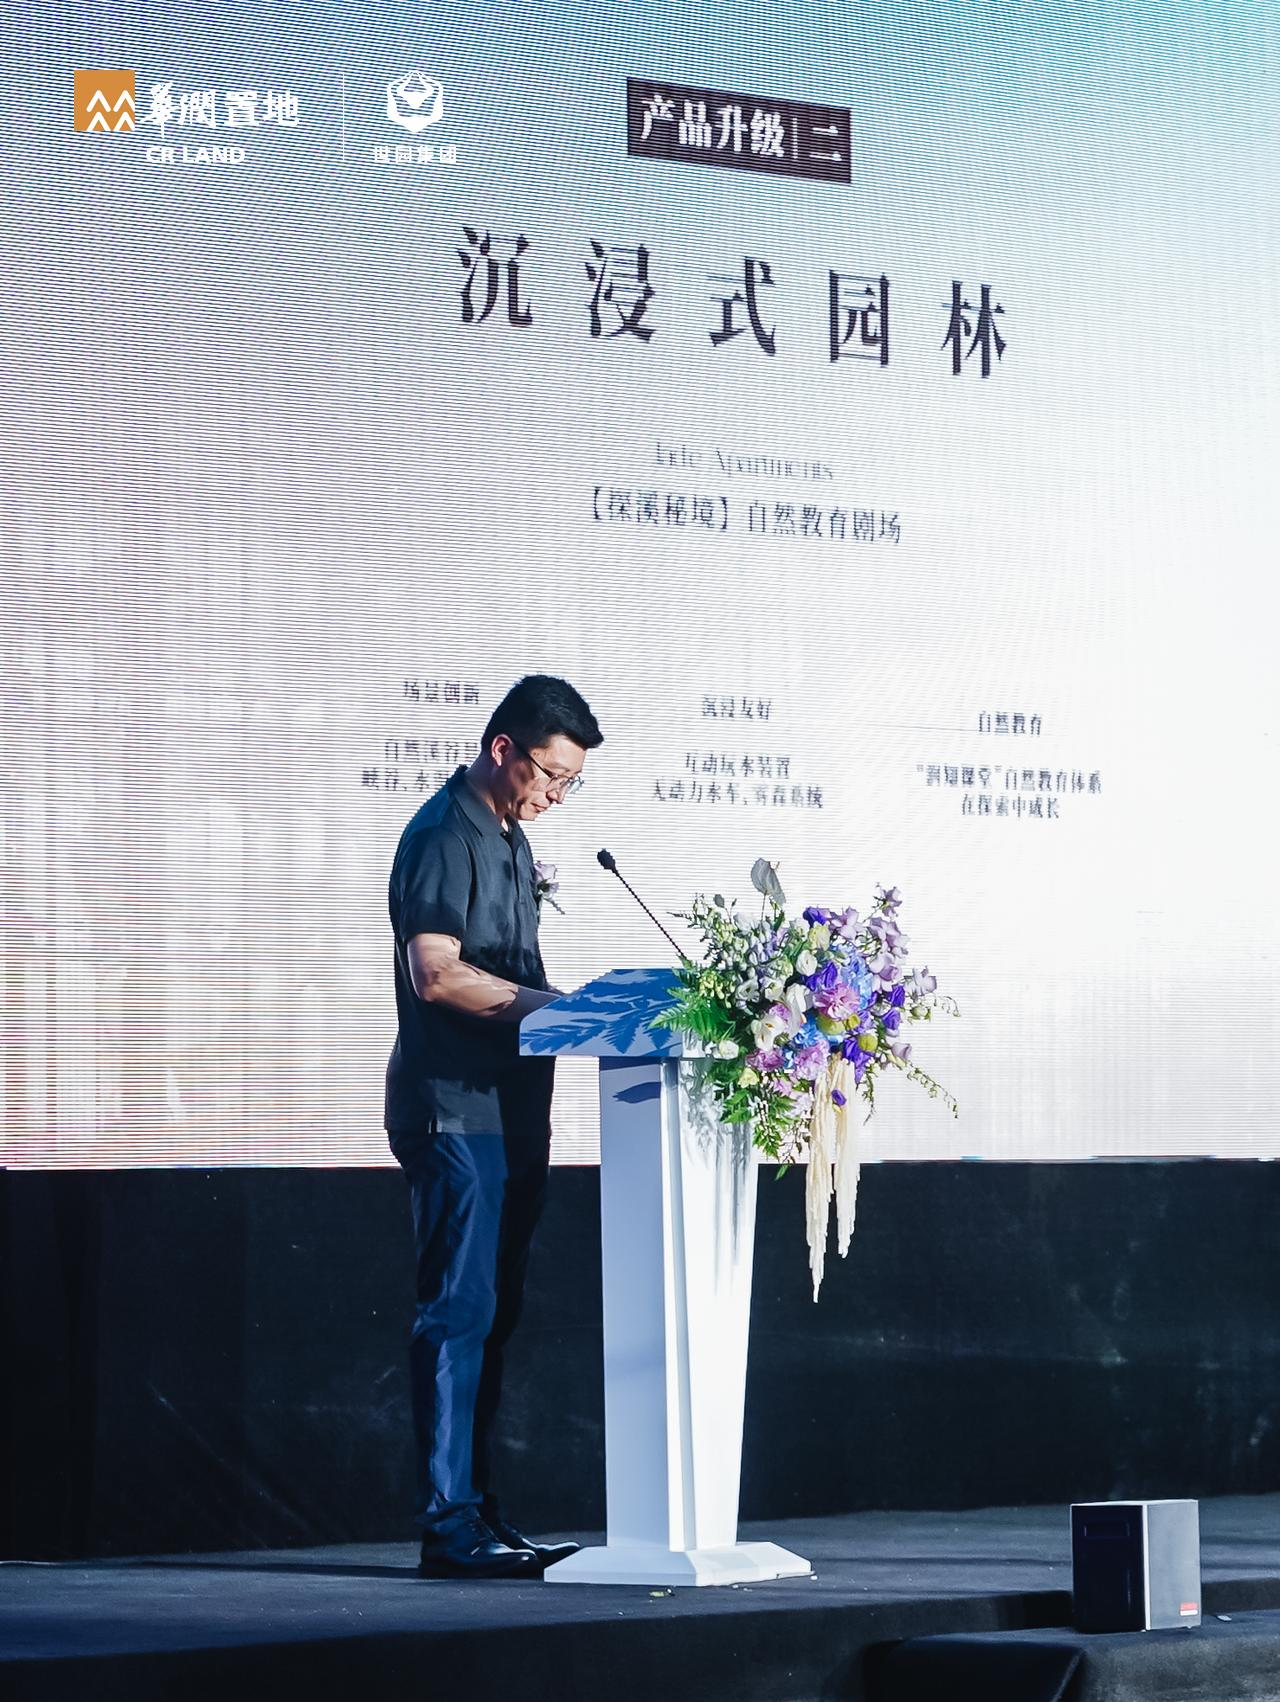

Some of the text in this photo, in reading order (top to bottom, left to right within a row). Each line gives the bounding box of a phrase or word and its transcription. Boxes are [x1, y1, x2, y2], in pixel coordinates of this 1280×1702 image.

[457, 226, 1008, 379] 沉浸式园林
[979, 711, 1042, 737] 自然教育
